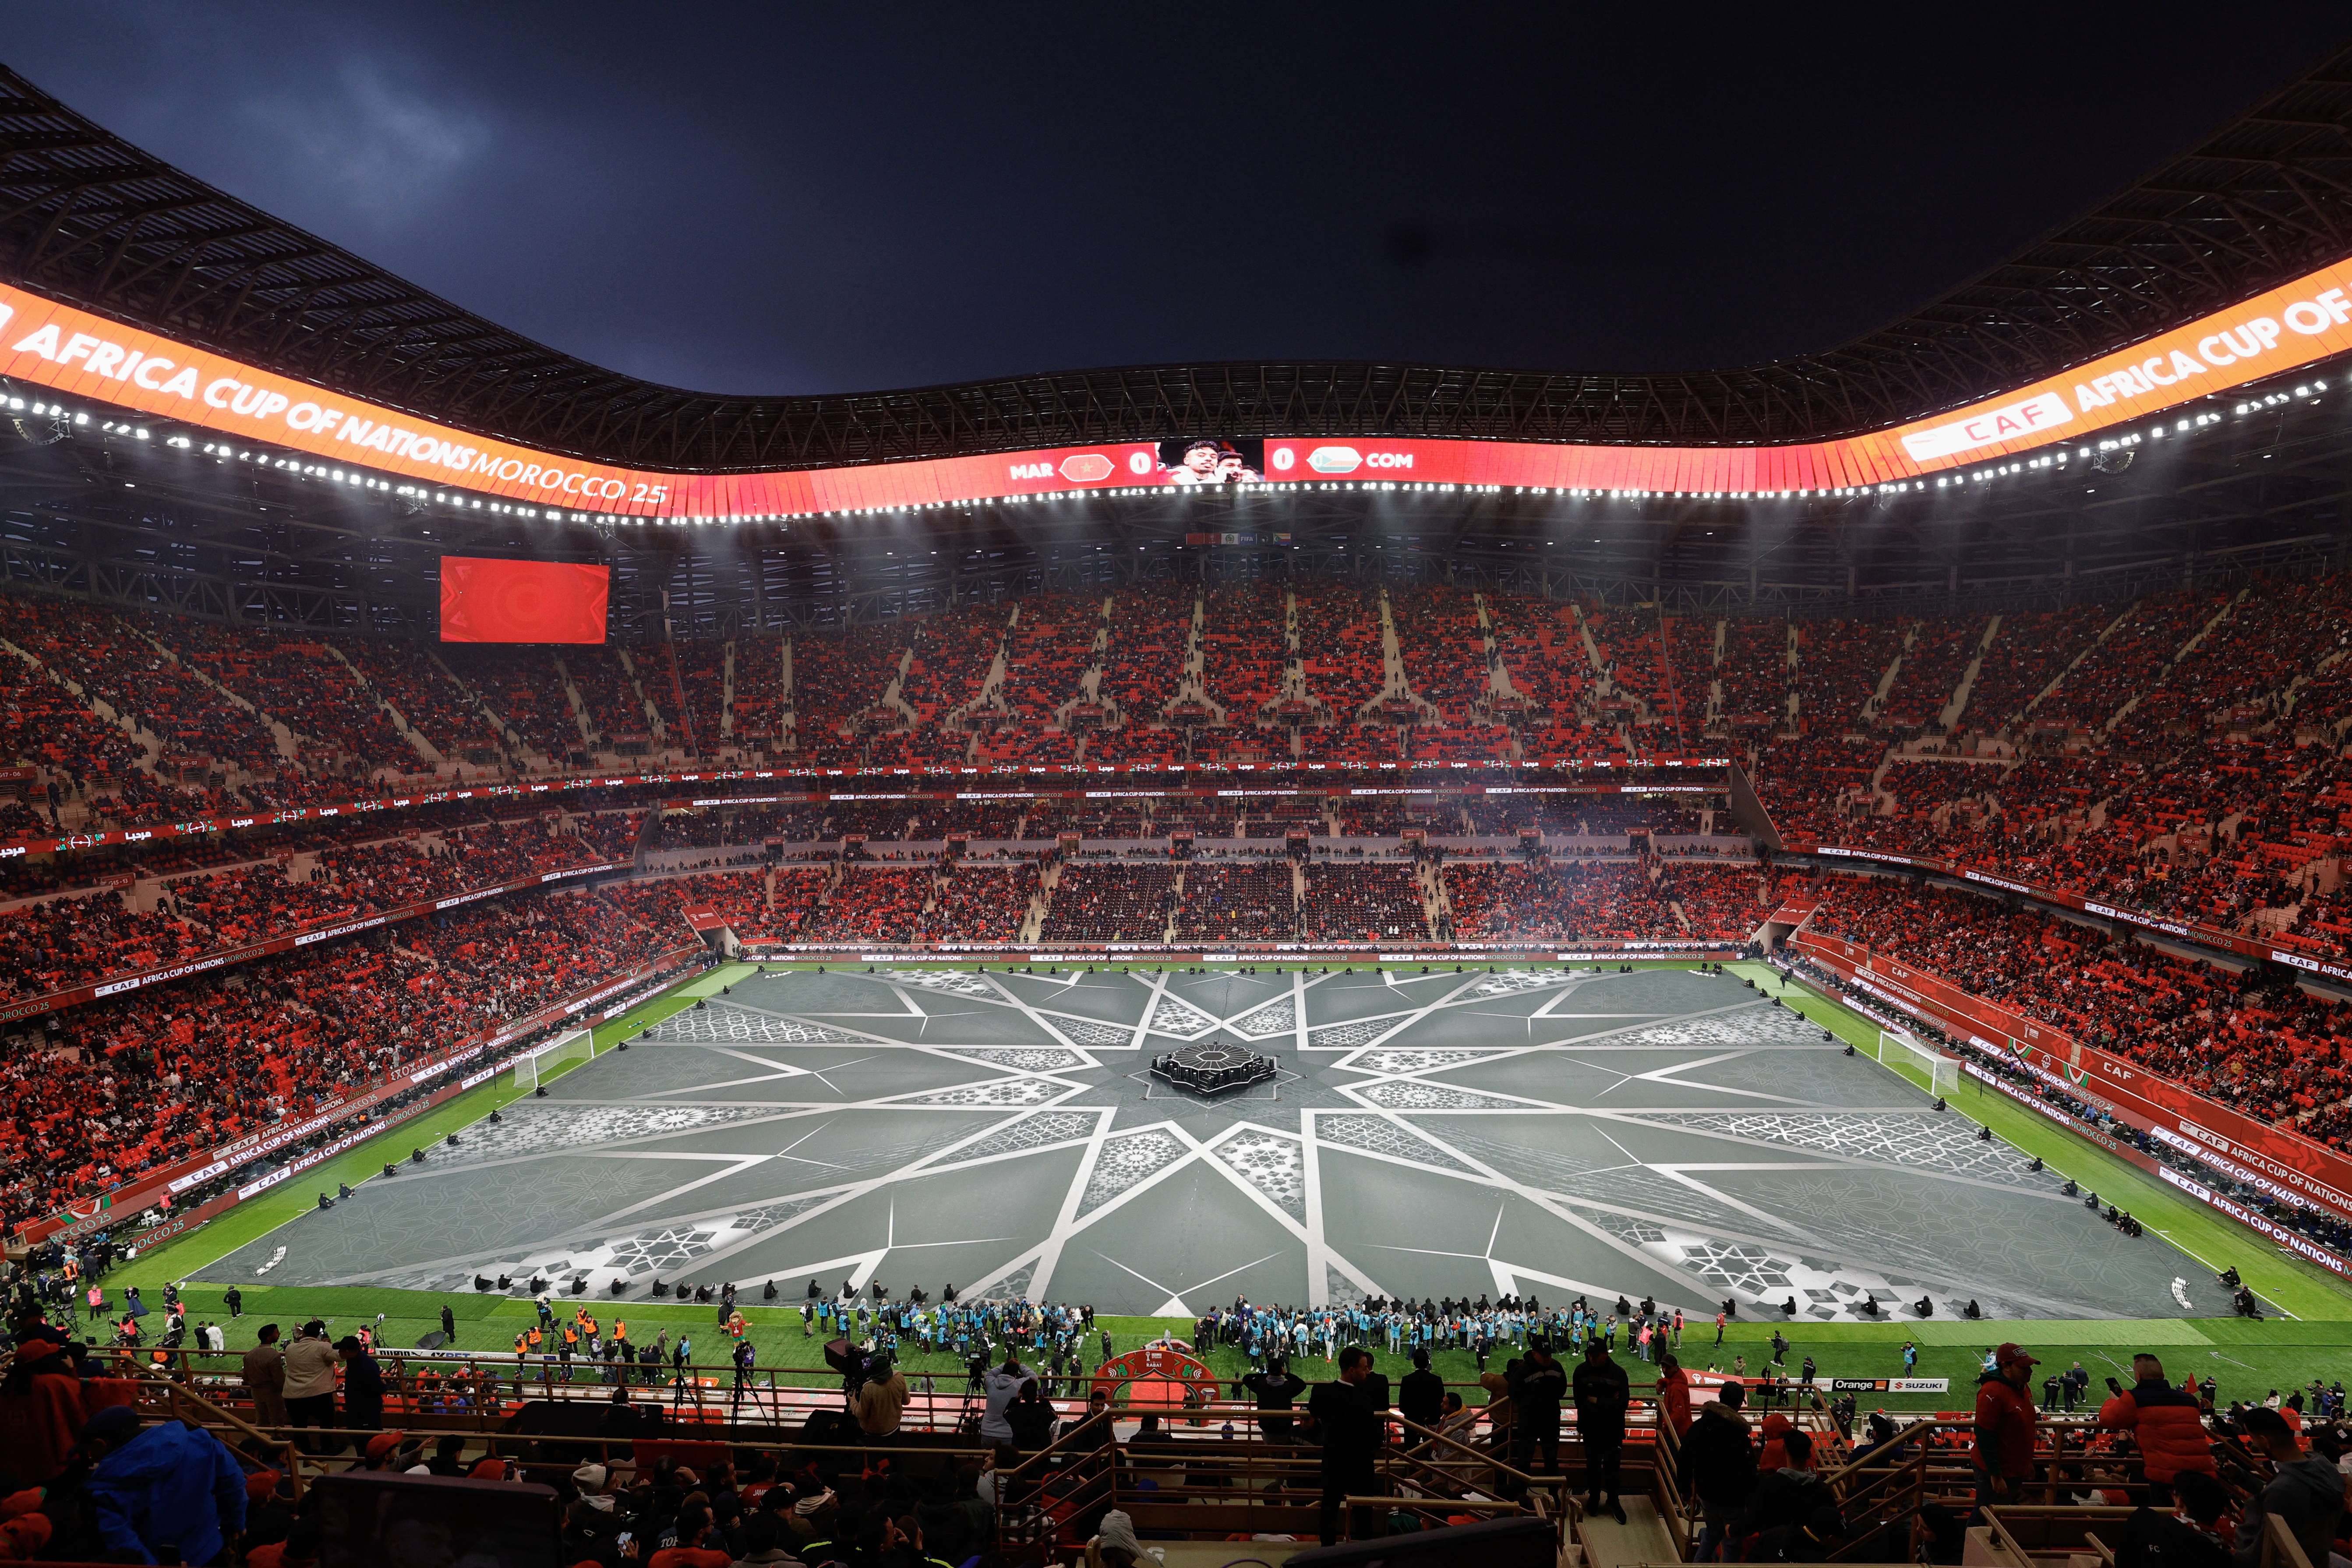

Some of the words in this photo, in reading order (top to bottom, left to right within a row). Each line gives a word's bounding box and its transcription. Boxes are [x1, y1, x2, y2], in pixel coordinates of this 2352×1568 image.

[1964, 404, 2043, 441] CAF
[2073, 351, 2207, 411] AFRICA
[2198, 317, 2279, 365] CUP
[2284, 288, 2351, 333] OF
[12, 324, 197, 399] AFRICA
[204, 378, 288, 418] CUP
[286, 403, 343, 434] OF
[335, 416, 477, 470] NATIONS
[470, 456, 625, 499] MOROCCO
[629, 484, 667, 504] 25
[1010, 463, 1053, 480] MAR
[1130, 452, 1151, 475] 0
[1273, 448, 1294, 470] 0
[1366, 453, 1413, 469] COM
[125, 831, 152, 841] مرحبا
[1889, 856, 1911, 864] NATIONS
[1911, 860, 1935, 868] MOROCCO
[2096, 906, 2112, 914] CAF
[2116, 911, 2137, 923] AFRICA
[2138, 916, 2150, 925] CUP
[2160, 923, 2187, 936] NATIONS
[2187, 930, 2222, 945] MOROCCO
[2224, 939, 2232, 947] 25
[112, 980, 136, 992] CAF
[141, 972, 169, 985] AFRICA
[170, 968, 184, 978] CUP
[184, 966, 194, 974] OF
[194, 957, 224, 971] NATIONS
[224, 950, 257, 963] MOROCCO
[1892, 967, 1908, 978] CAF
[2289, 957, 2313, 967] CAF
[2321, 965, 2352, 980] AFRICA
[40, 1002, 49, 1010] 25
[1875, 977, 1889, 989] AFRICA
[1889, 983, 1897, 992] CUP
[1903, 990, 1921, 1003] NATIONS
[1920, 999, 1943, 1014] MOROCCO
[2104, 1062, 2132, 1079] CAF
[1977, 1070, 1993, 1082] CAF
[1997, 1081, 2018, 1095] AFRICA
[2019, 1092, 2032, 1103] CUP
[2032, 1099, 2041, 1110] OF
[2041, 1105, 2070, 1126] NATIONS
[2069, 1120, 2107, 1144] MOROCCO
[2108, 1140, 2117, 1150] 25
[191, 1163, 221, 1181] CAF
[230, 1145, 265, 1165] AFRICA
[265, 1137, 281, 1151] CUP
[282, 1131, 294, 1141] OF
[296, 1115, 331, 1136] NATIONS
[329, 1098, 368, 1120] MOROCCO
[259, 1171, 286, 1188] CAF
[293, 1153, 324, 1172] AFRICA
[324, 1143, 340, 1156] CUP
[341, 1137, 353, 1148] OF
[354, 1120, 385, 1141] NATIONS
[386, 1107, 421, 1126] MOROCCO
[422, 1099, 429, 1109] 25
[2197, 1130, 2224, 1147] CAF
[2230, 1147, 2266, 1170] AFRICA
[2267, 1164, 2288, 1178] CUP
[2288, 1174, 2303, 1187] OF
[2305, 1180, 2352, 1211] NATIONS
[96, 1212, 112, 1224] 25
[172, 1219, 184, 1231] 25
[2178, 1177, 2207, 1198] CAF
[2212, 1197, 2250, 1223] AFRICA
[2250, 1216, 2272, 1233] CUP
[2273, 1228, 2288, 1243] OF
[2290, 1236, 2342, 1272] NATIONS
[1836, 1380, 1873, 1390] Orange
